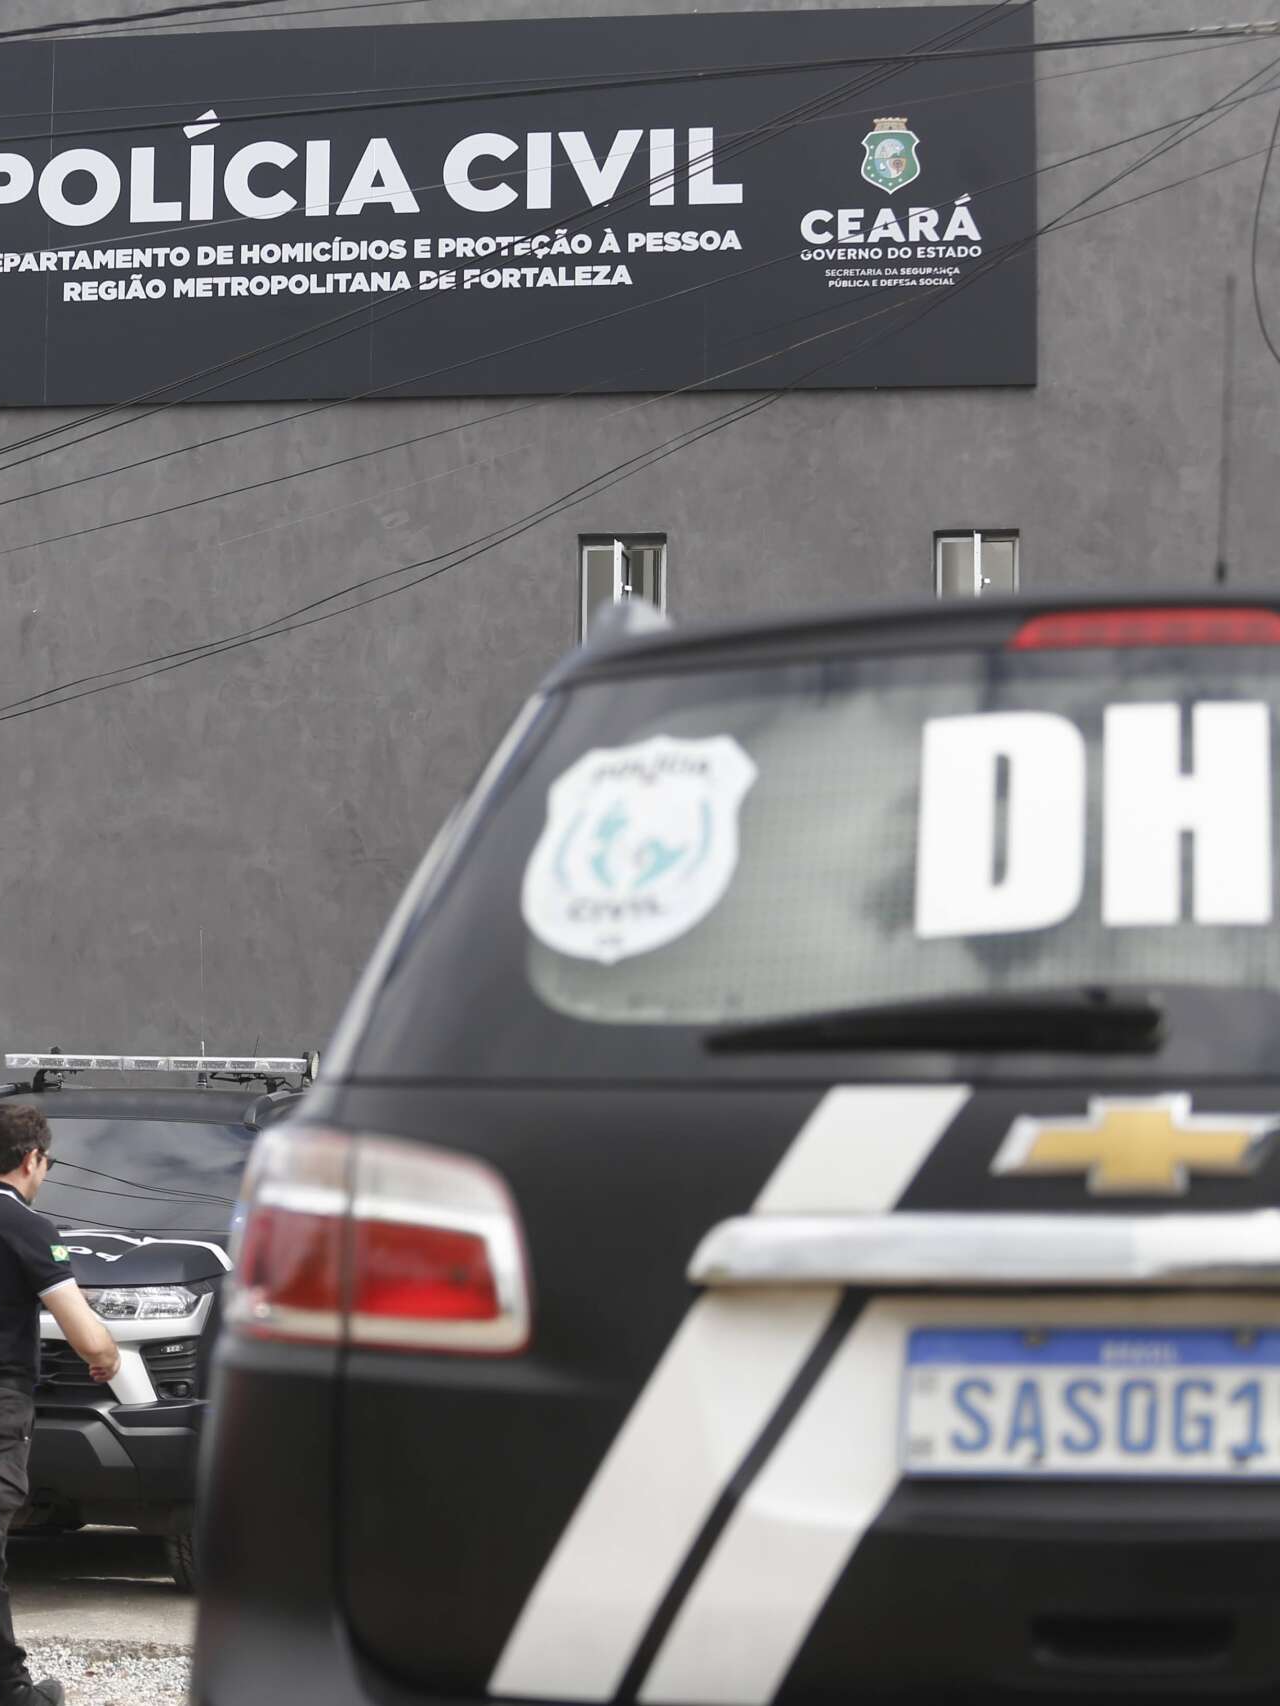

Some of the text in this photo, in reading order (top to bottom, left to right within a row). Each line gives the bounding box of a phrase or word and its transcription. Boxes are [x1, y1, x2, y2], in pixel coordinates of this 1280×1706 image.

[442, 126, 744, 214] CIVIL
[800, 193, 982, 245] CEARÁ
[197, 245, 234, 266] DE
[240, 236, 407, 264] HOMICÍDIOS
[413, 238, 432, 259] E
[438, 229, 593, 259] PROTEÇÃO
[598, 228, 622, 253] À
[627, 229, 743, 253] PESSOA
[800, 245, 982, 261] GOVERNO DO ESTADO
[63, 264, 633, 302] REGIÃO METROPOLITANA DE FORTALEZA
[825, 266, 961, 277] SECRETARIA DA SEGURANÇA
[828, 278, 871, 288] PÚBLICA
[880, 279, 918, 287] DEFESA
[919, 278, 956, 287] SOCIAL
[918, 702, 1271, 937] DH
